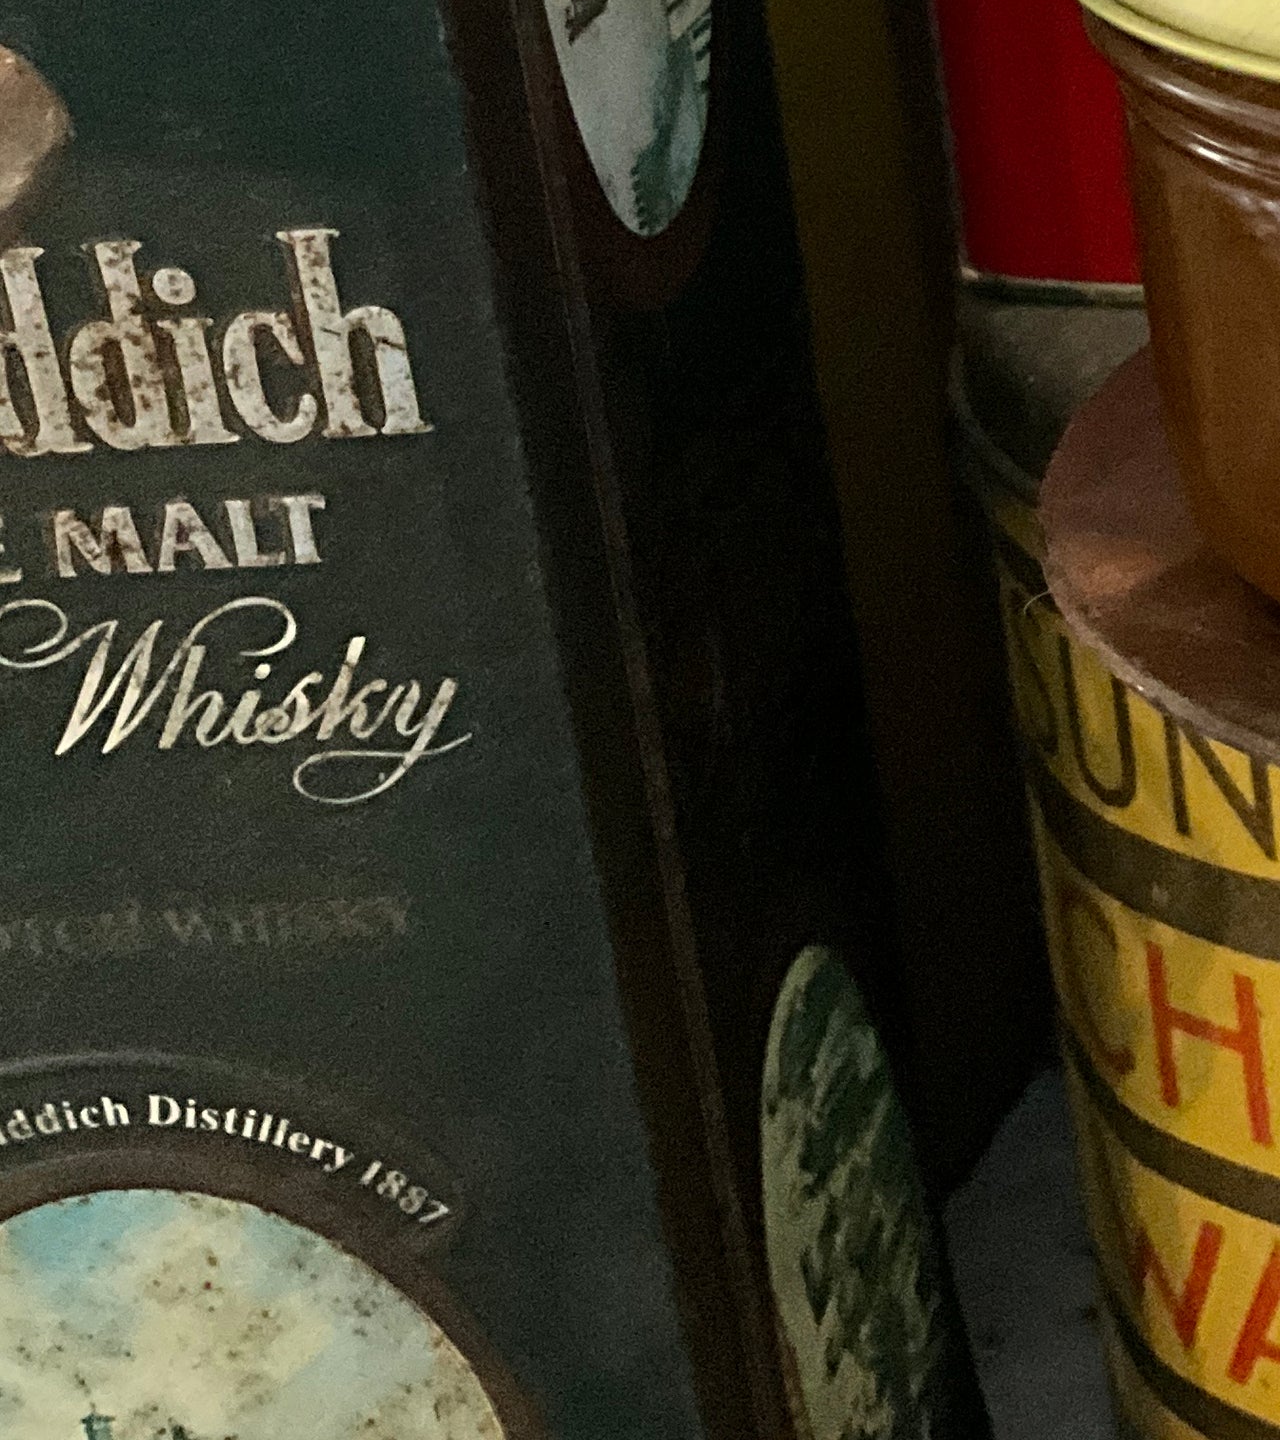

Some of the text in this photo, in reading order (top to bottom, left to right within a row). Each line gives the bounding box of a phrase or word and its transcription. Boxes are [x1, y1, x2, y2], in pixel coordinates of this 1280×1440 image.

[52, 494, 326, 578] MALT
[0, 596, 472, 804] Whisky
[148, 1094, 355, 1173] Distillery
[360, 1160, 450, 1223] 1887
